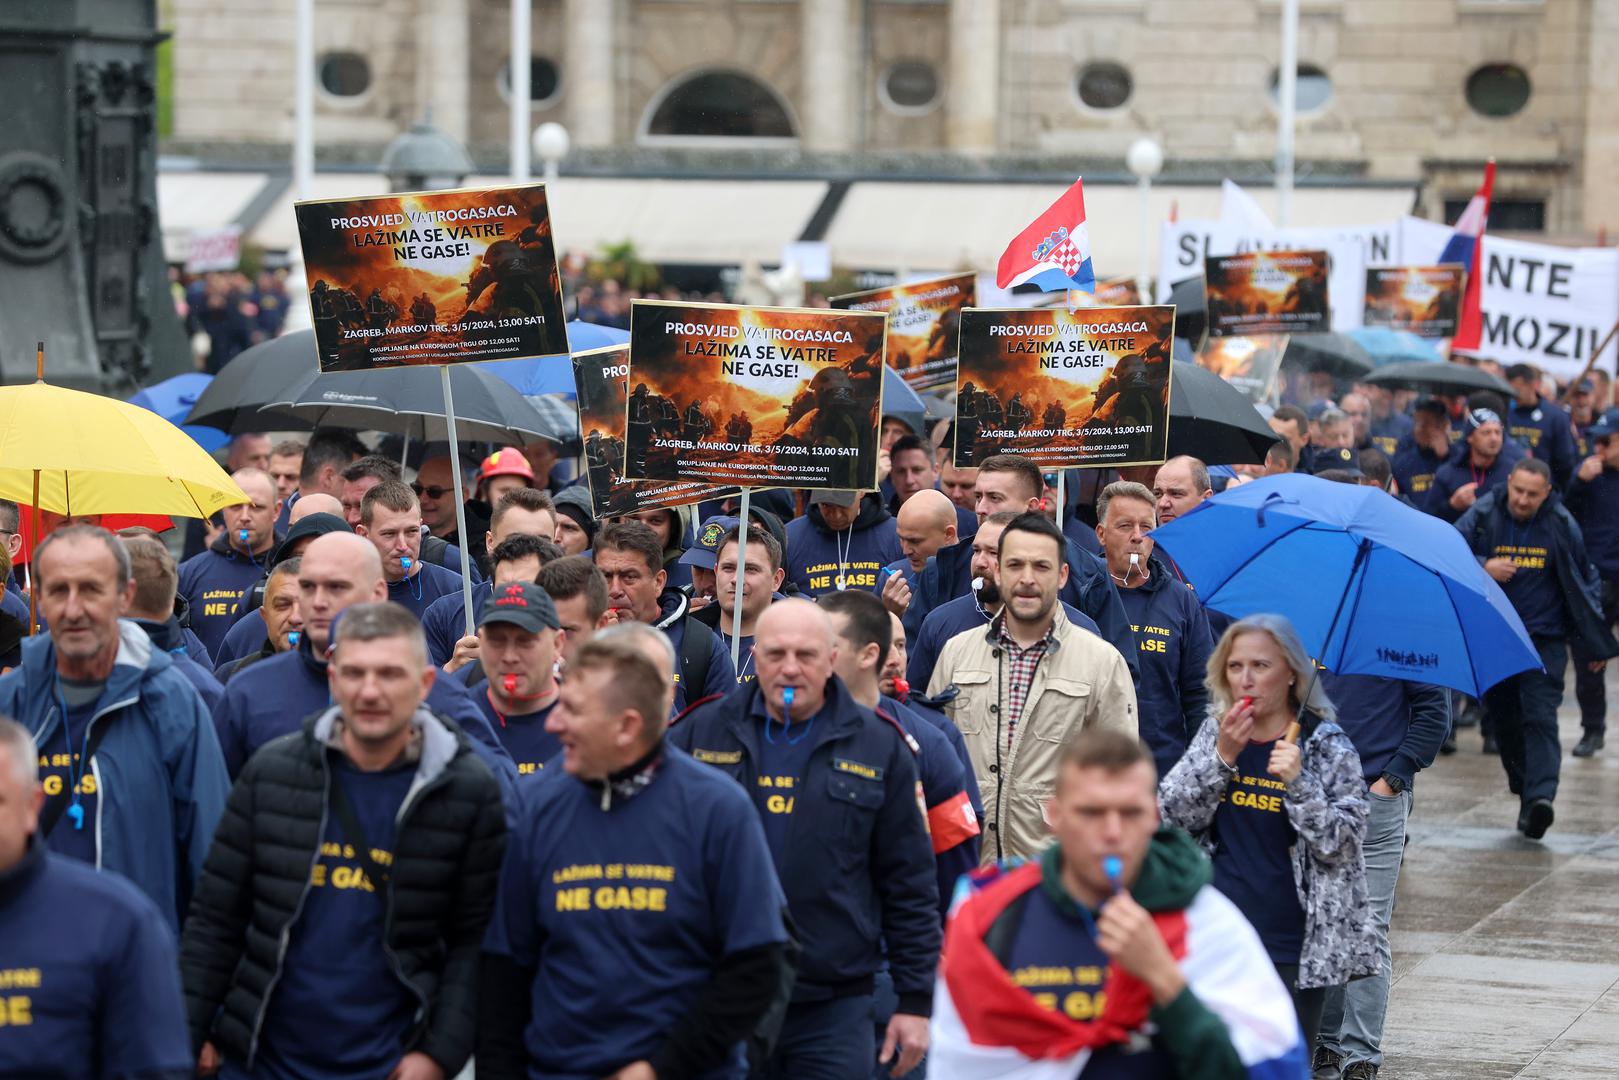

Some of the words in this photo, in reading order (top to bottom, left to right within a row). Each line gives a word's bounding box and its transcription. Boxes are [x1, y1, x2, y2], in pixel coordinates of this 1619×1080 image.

[330, 213, 405, 230] PROSVJED
[405, 205, 518, 224] VATROGASACA
[353, 229, 422, 248] LAŽIMA
[424, 229, 444, 243] SE
[447, 222, 506, 241] VATRE
[393, 246, 418, 261] NE
[420, 243, 471, 259] GASE!
[344, 328, 385, 339] ZAGREB,
[385, 324, 429, 336] MARKOV
[429, 324, 451, 334] TRG,
[452, 319, 498, 332] 3/5/2024,
[498, 318, 523, 329] 13,00
[524, 316, 546, 325] SATI
[665, 322, 740, 338] PROSVJED
[742, 326, 853, 344] VATROGASACA
[990, 325, 1055, 336] PROSVJED
[1057, 322, 1149, 335] VATROGASACA
[369, 344, 409, 354] OKUPLJANJE
[410, 343, 420, 351] NA
[420, 341, 459, 351] EUROPSKOM
[460, 340, 478, 348] TRGU
[685, 340, 752, 359] LAŽIMA
[755, 346, 776, 360] SE
[780, 347, 838, 362] VATRE
[1007, 339, 1066, 354] LAŽIMA
[1069, 341, 1085, 353] SE
[1089, 338, 1136, 352] VATRE
[1040, 357, 1059, 369] NE
[1063, 355, 1104, 368] GASE!
[722, 361, 745, 376] NE
[749, 363, 799, 378] GASE!
[981, 430, 1017, 439] ZAGREB,
[1018, 429, 1055, 438] MARKOV
[1056, 429, 1075, 437] TRG,
[1076, 427, 1113, 436] 3/5/2024,
[1114, 427, 1134, 435] 13,00
[1135, 425, 1153, 433] SATI
[655, 439, 696, 450] ZAGREB,
[697, 442, 741, 453] MARKOV
[742, 444, 764, 454] TRG,
[765, 445, 810, 456] 3/5/2024,
[812, 447, 836, 457] 13,00
[837, 448, 859, 457] SATI
[677, 459, 717, 468] OKUPLJANJE
[728, 463, 769, 471] EUROPSKOM
[636, 485, 669, 498] OKUPLJANJE
[806, 562, 838, 574] LAŽIMA
[852, 562, 880, 570] VATRE
[810, 576, 831, 590] NE
[203, 590, 236, 600] LAŽIMA
[205, 603, 228, 616] NE
[52, 754, 71, 767] SE
[518, 762, 536, 775] SE
[775, 776, 794, 788] SE
[1242, 776, 1257, 786] SE
[1231, 790, 1282, 813] GASE
[605, 864, 624, 880] SE
[556, 887, 592, 913] NE
[594, 886, 668, 913] GASE
